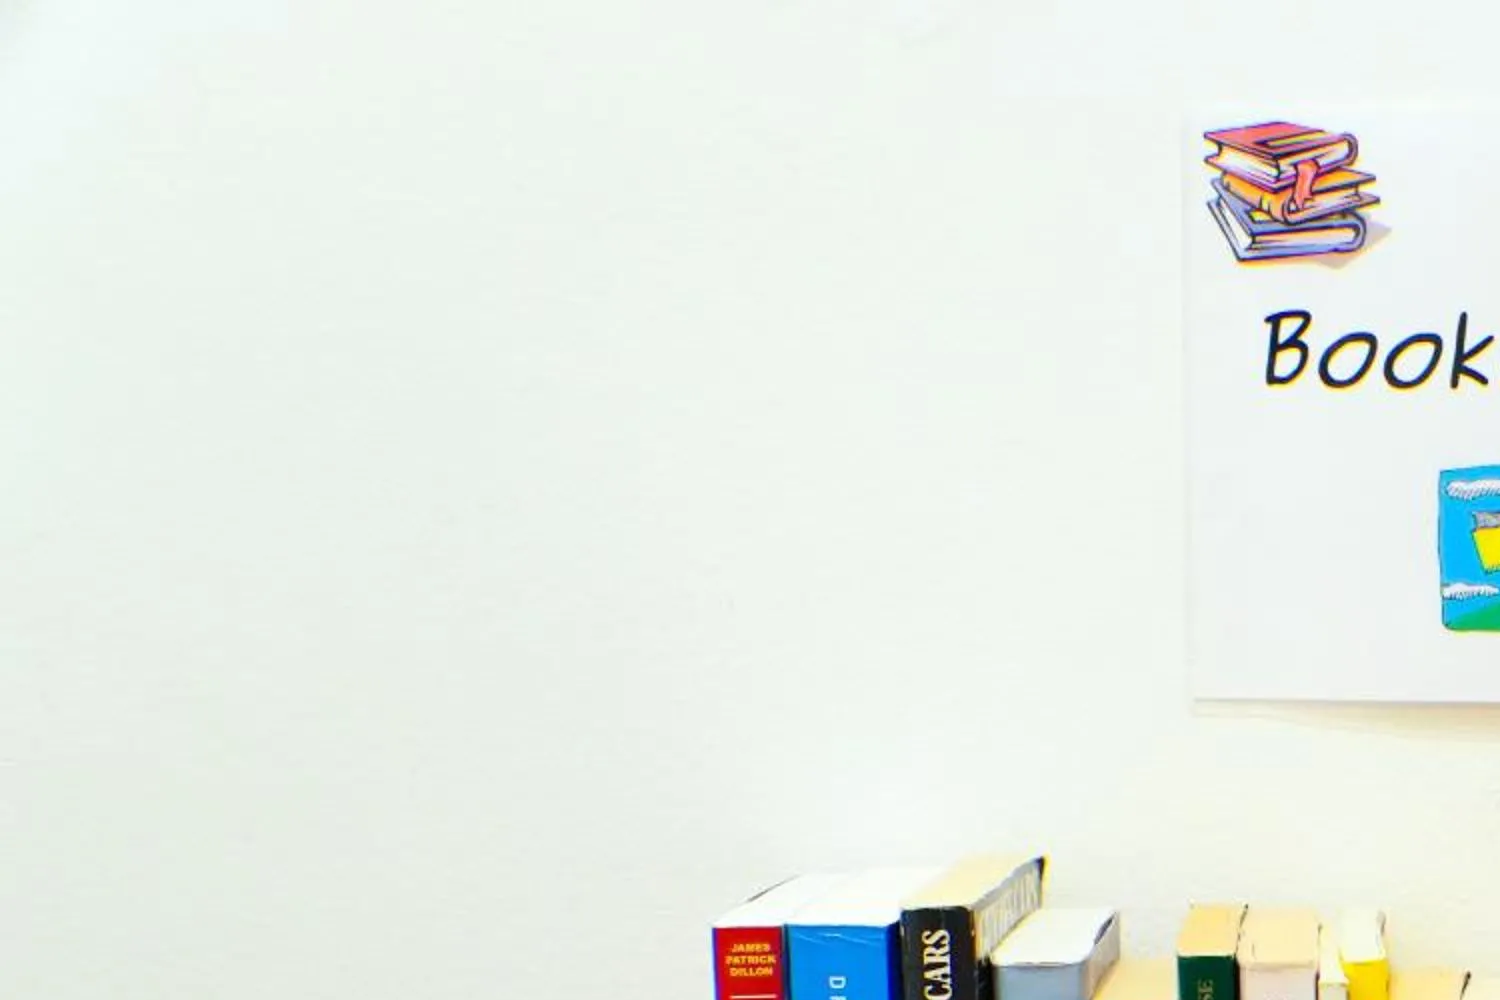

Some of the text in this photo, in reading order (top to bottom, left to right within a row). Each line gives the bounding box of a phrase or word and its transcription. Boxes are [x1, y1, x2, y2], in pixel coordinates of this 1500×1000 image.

[731, 943, 771, 953] JAMES
[725, 954, 776, 965] PATRICK
[729, 966, 773, 976] DILLON
